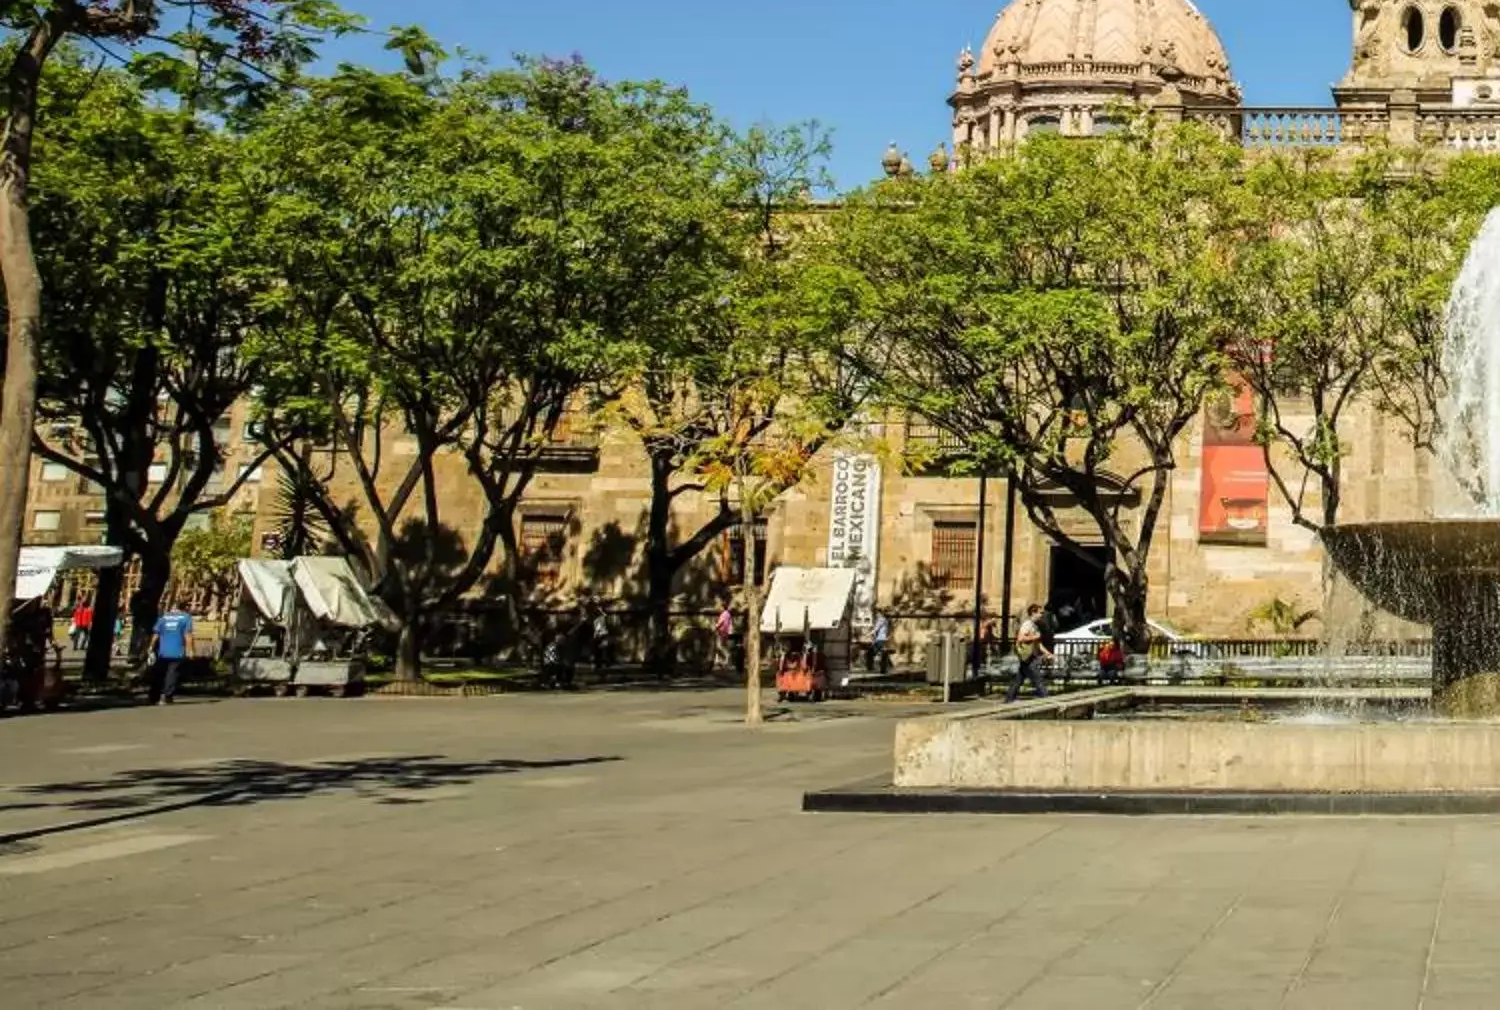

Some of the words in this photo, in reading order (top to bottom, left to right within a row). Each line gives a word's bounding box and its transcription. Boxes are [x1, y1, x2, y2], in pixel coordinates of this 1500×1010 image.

[833, 456, 849, 539] BARROCO
[848, 458, 868, 560] MEXICANO
[831, 540, 845, 561] EL
